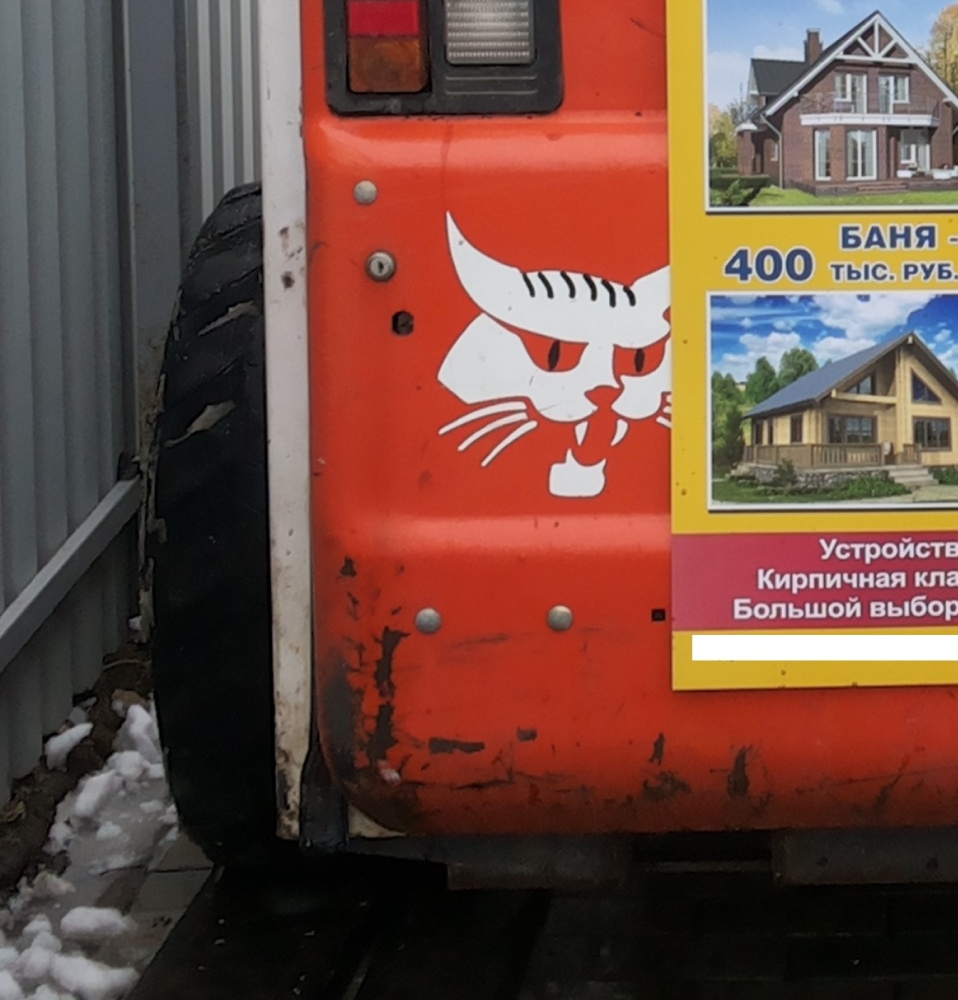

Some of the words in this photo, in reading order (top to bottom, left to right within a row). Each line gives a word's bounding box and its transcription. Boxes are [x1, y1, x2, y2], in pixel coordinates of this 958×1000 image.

[841, 226, 936, 248] БАНЯ
[724, 249, 814, 281] 400
[830, 264, 895, 281] ТЫС.
[757, 568, 907, 593] Кирпичная
[733, 597, 862, 620] Большой
